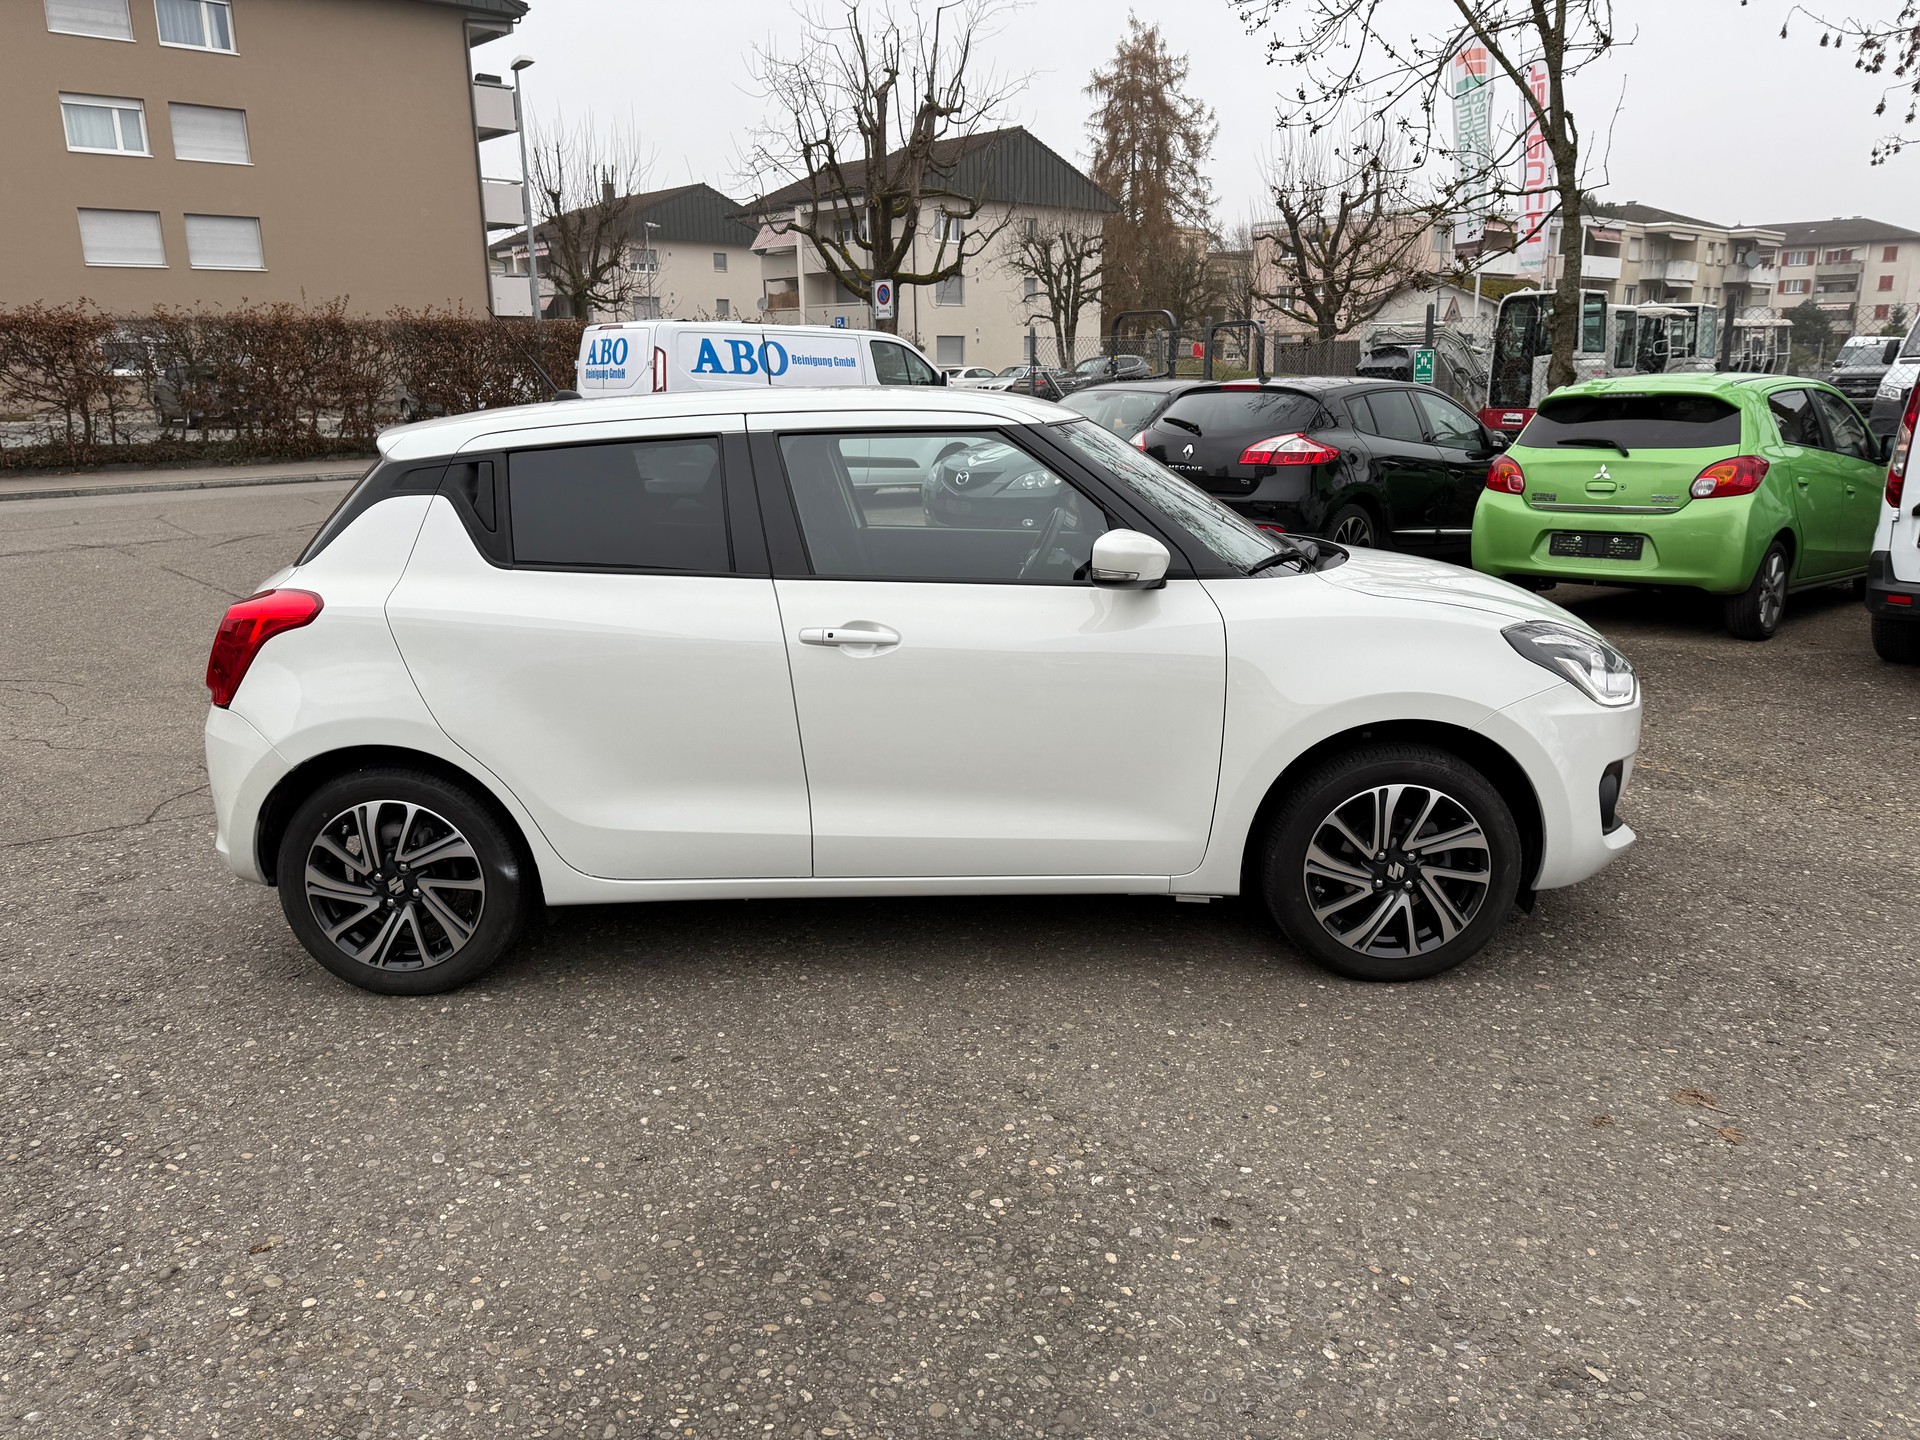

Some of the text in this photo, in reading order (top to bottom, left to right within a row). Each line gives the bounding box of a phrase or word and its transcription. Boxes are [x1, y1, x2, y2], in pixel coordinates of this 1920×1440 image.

[586, 338, 628, 365] ABO
[691, 338, 788, 376] ABO
[792, 354, 856, 367] Reinigung GmbH
[586, 368, 625, 379] Reinigung GmbH
